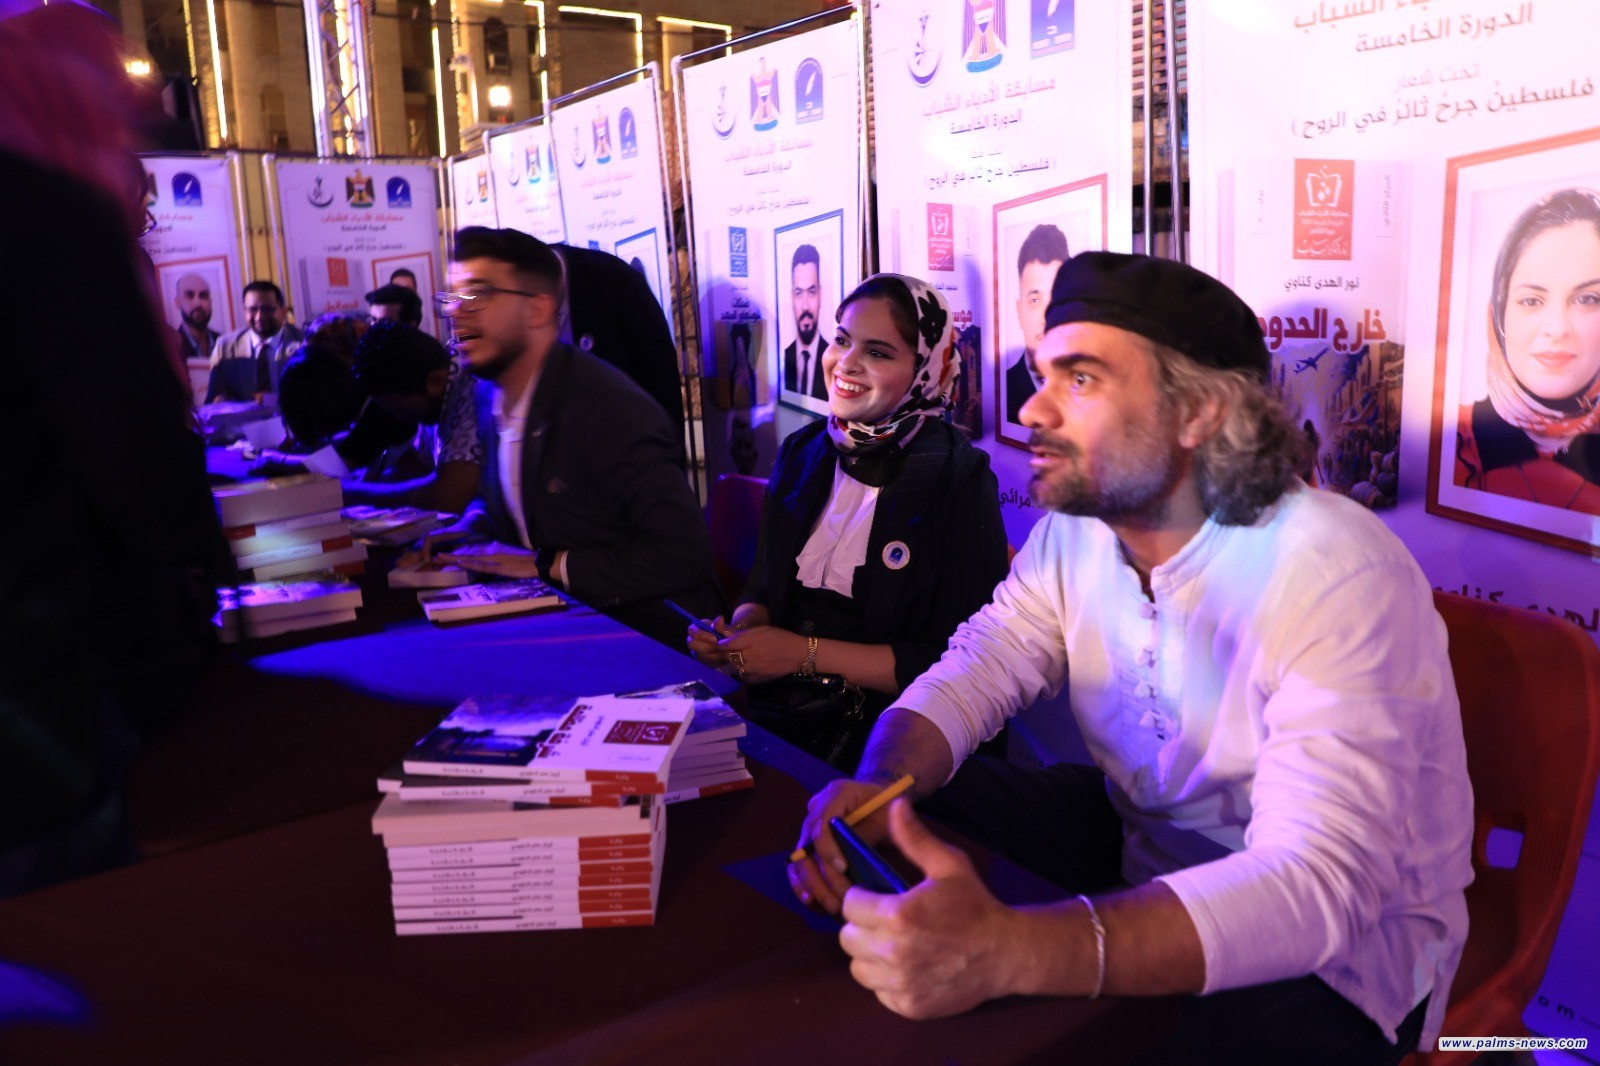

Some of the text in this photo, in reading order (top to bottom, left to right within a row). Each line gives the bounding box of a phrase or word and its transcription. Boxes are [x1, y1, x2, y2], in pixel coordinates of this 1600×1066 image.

[1355, 1, 1534, 52] الدورة الخامسة
[1344, 276, 1360, 291] نور
[1333, 309, 1386, 352] خارج
